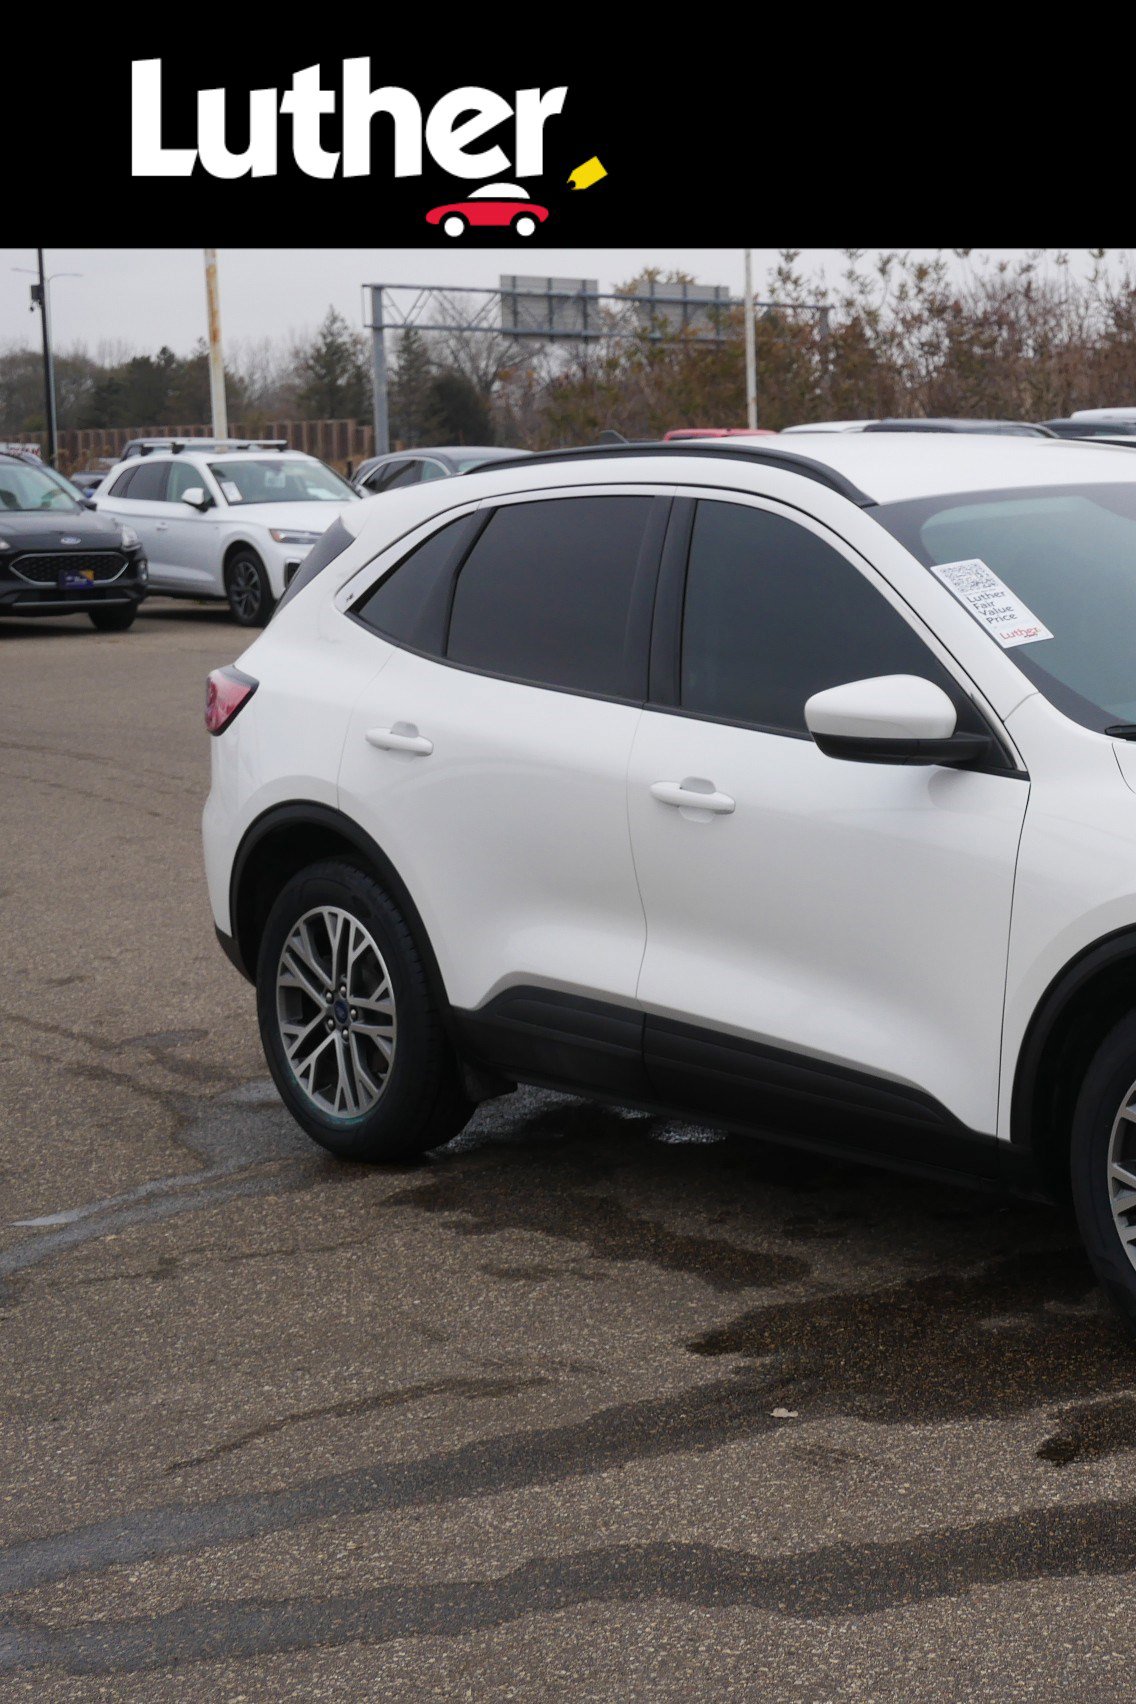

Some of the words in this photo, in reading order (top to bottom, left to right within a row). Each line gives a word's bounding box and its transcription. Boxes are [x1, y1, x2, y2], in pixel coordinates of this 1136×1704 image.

[966, 590, 1006, 603] Luther
[973, 601, 995, 610] Fair
[978, 605, 1014, 616] Value
[986, 612, 1017, 624] Price
[999, 627, 1040, 639] Luther
